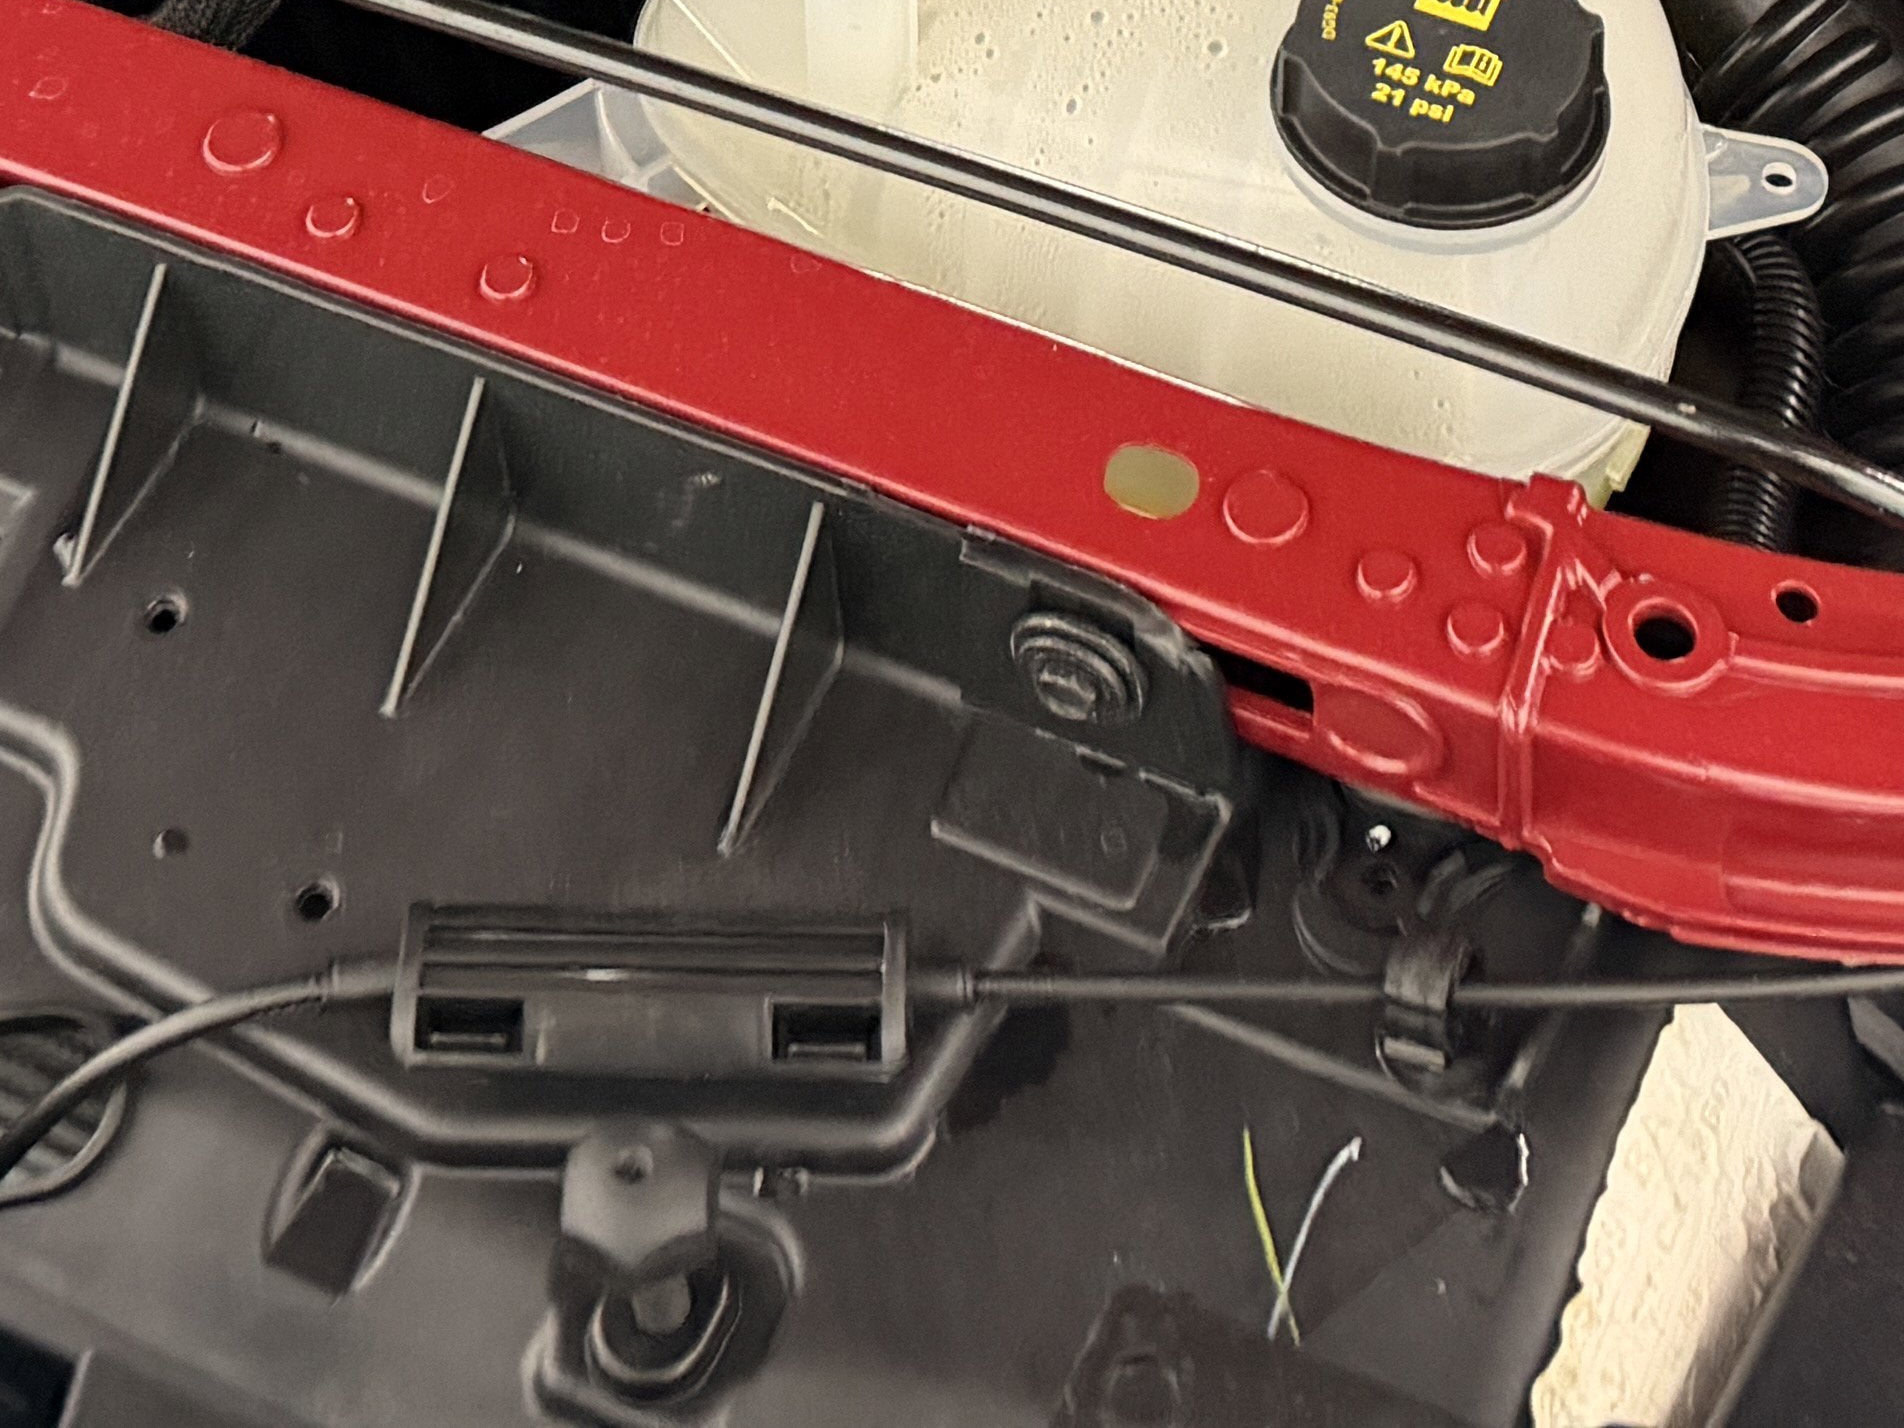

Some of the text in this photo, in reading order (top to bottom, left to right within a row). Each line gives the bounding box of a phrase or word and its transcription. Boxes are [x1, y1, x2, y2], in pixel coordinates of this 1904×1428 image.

[1371, 82, 1454, 123] 21 psi
[1372, 57, 1476, 106] 145 kPa
